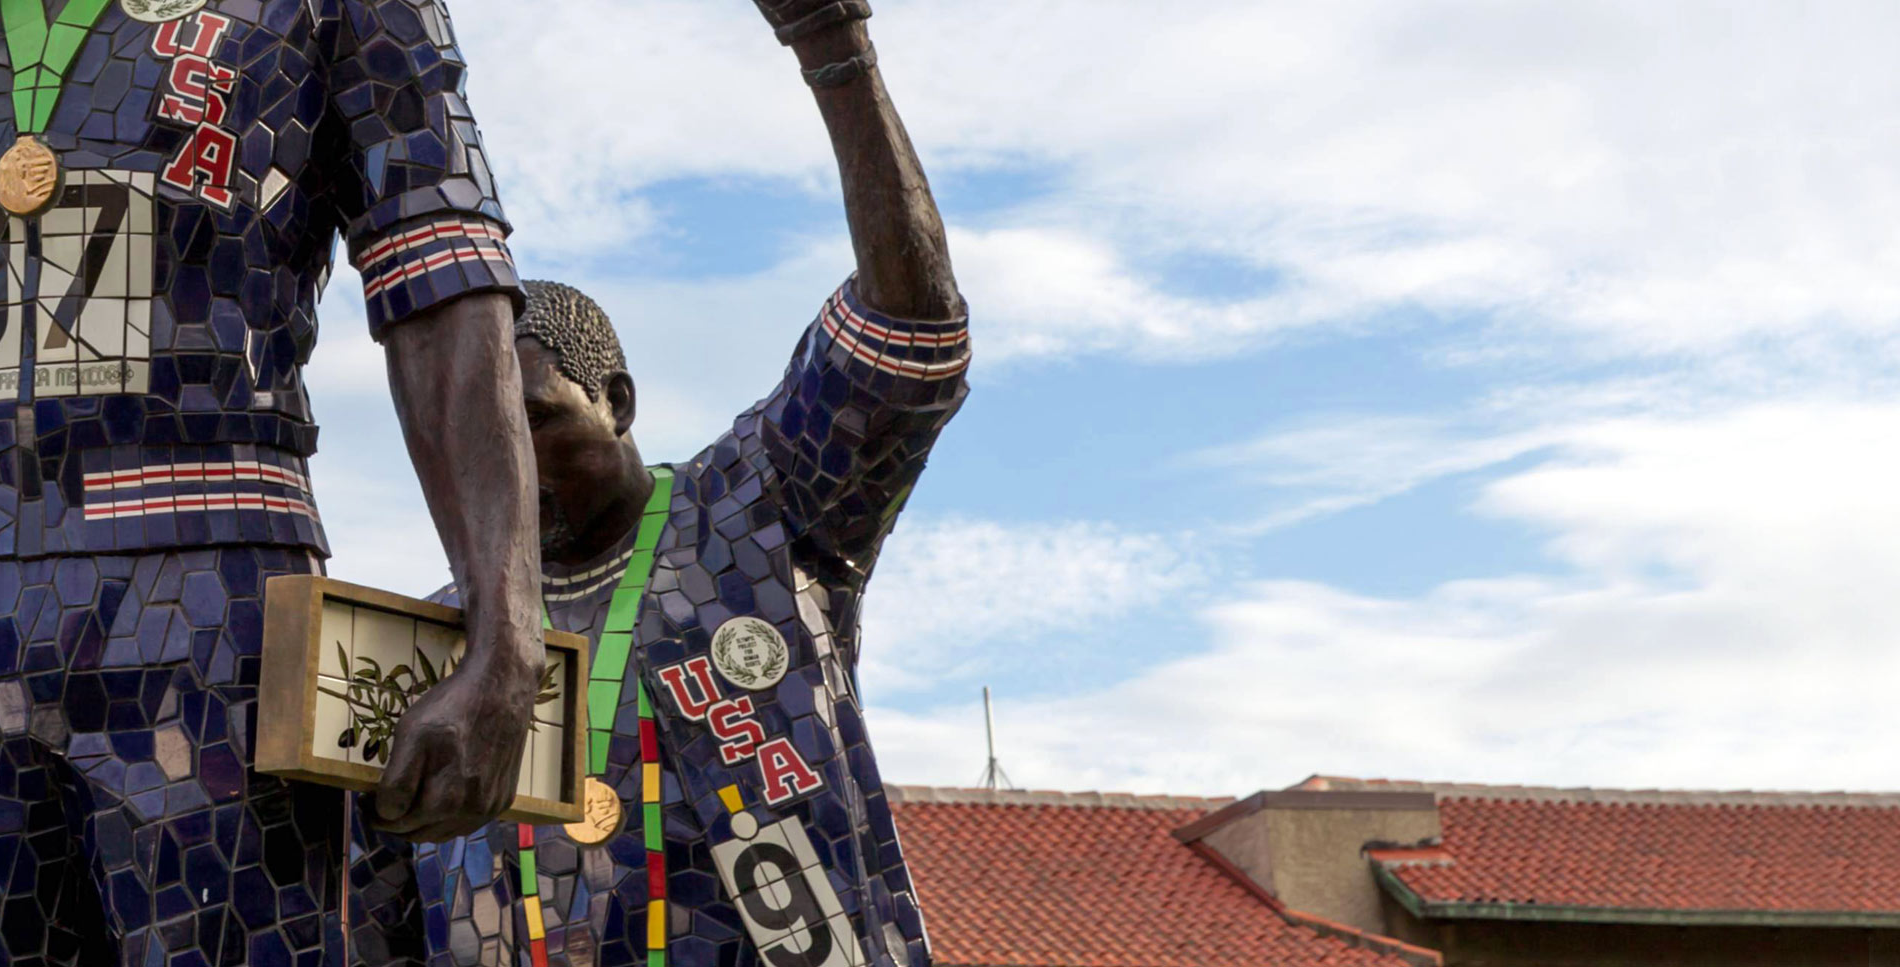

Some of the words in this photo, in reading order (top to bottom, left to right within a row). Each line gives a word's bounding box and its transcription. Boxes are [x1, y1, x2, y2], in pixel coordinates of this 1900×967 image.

[152, 10, 237, 209] USA
[658, 655, 824, 806] USA
[733, 842, 833, 967] 9
